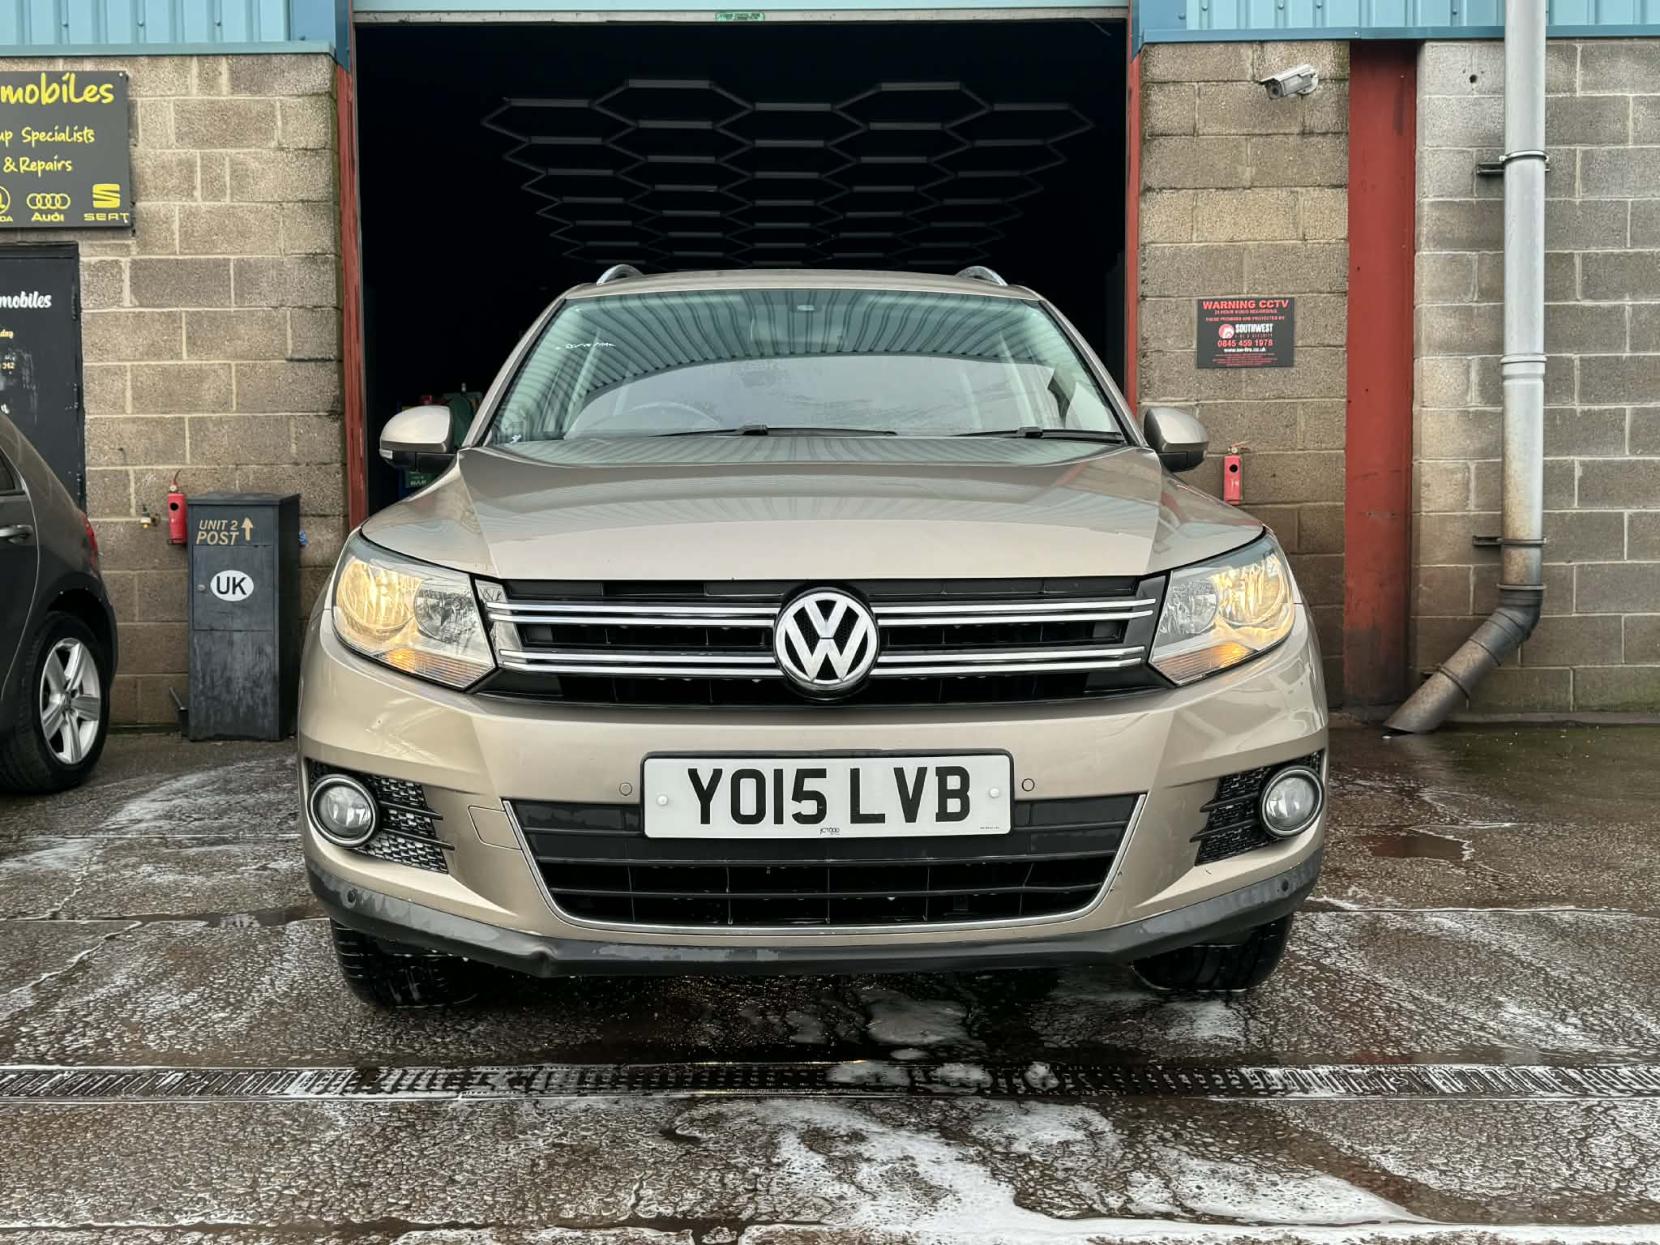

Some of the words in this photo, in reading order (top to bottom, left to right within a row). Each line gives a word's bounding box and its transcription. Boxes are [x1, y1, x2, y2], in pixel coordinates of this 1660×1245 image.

[21, 125, 96, 148] Specialists
[31, 212, 65, 222] Audi
[84, 212, 130, 222] SEAT
[1202, 300, 1256, 310] WARNING
[1259, 299, 1289, 309] CCTV
[1235, 323, 1274, 334] SOUTHWEST
[1217, 339, 1237, 348] 0845
[1238, 339, 1253, 347] 459
[1254, 338, 1274, 347] 1978
[199, 519, 228, 530] UNIT
[230, 520, 239, 531] 2
[196, 532, 240, 546] POST
[216, 576, 247, 596] UK
[687, 767, 828, 825] YO15
[849, 765, 971, 824] LVB
